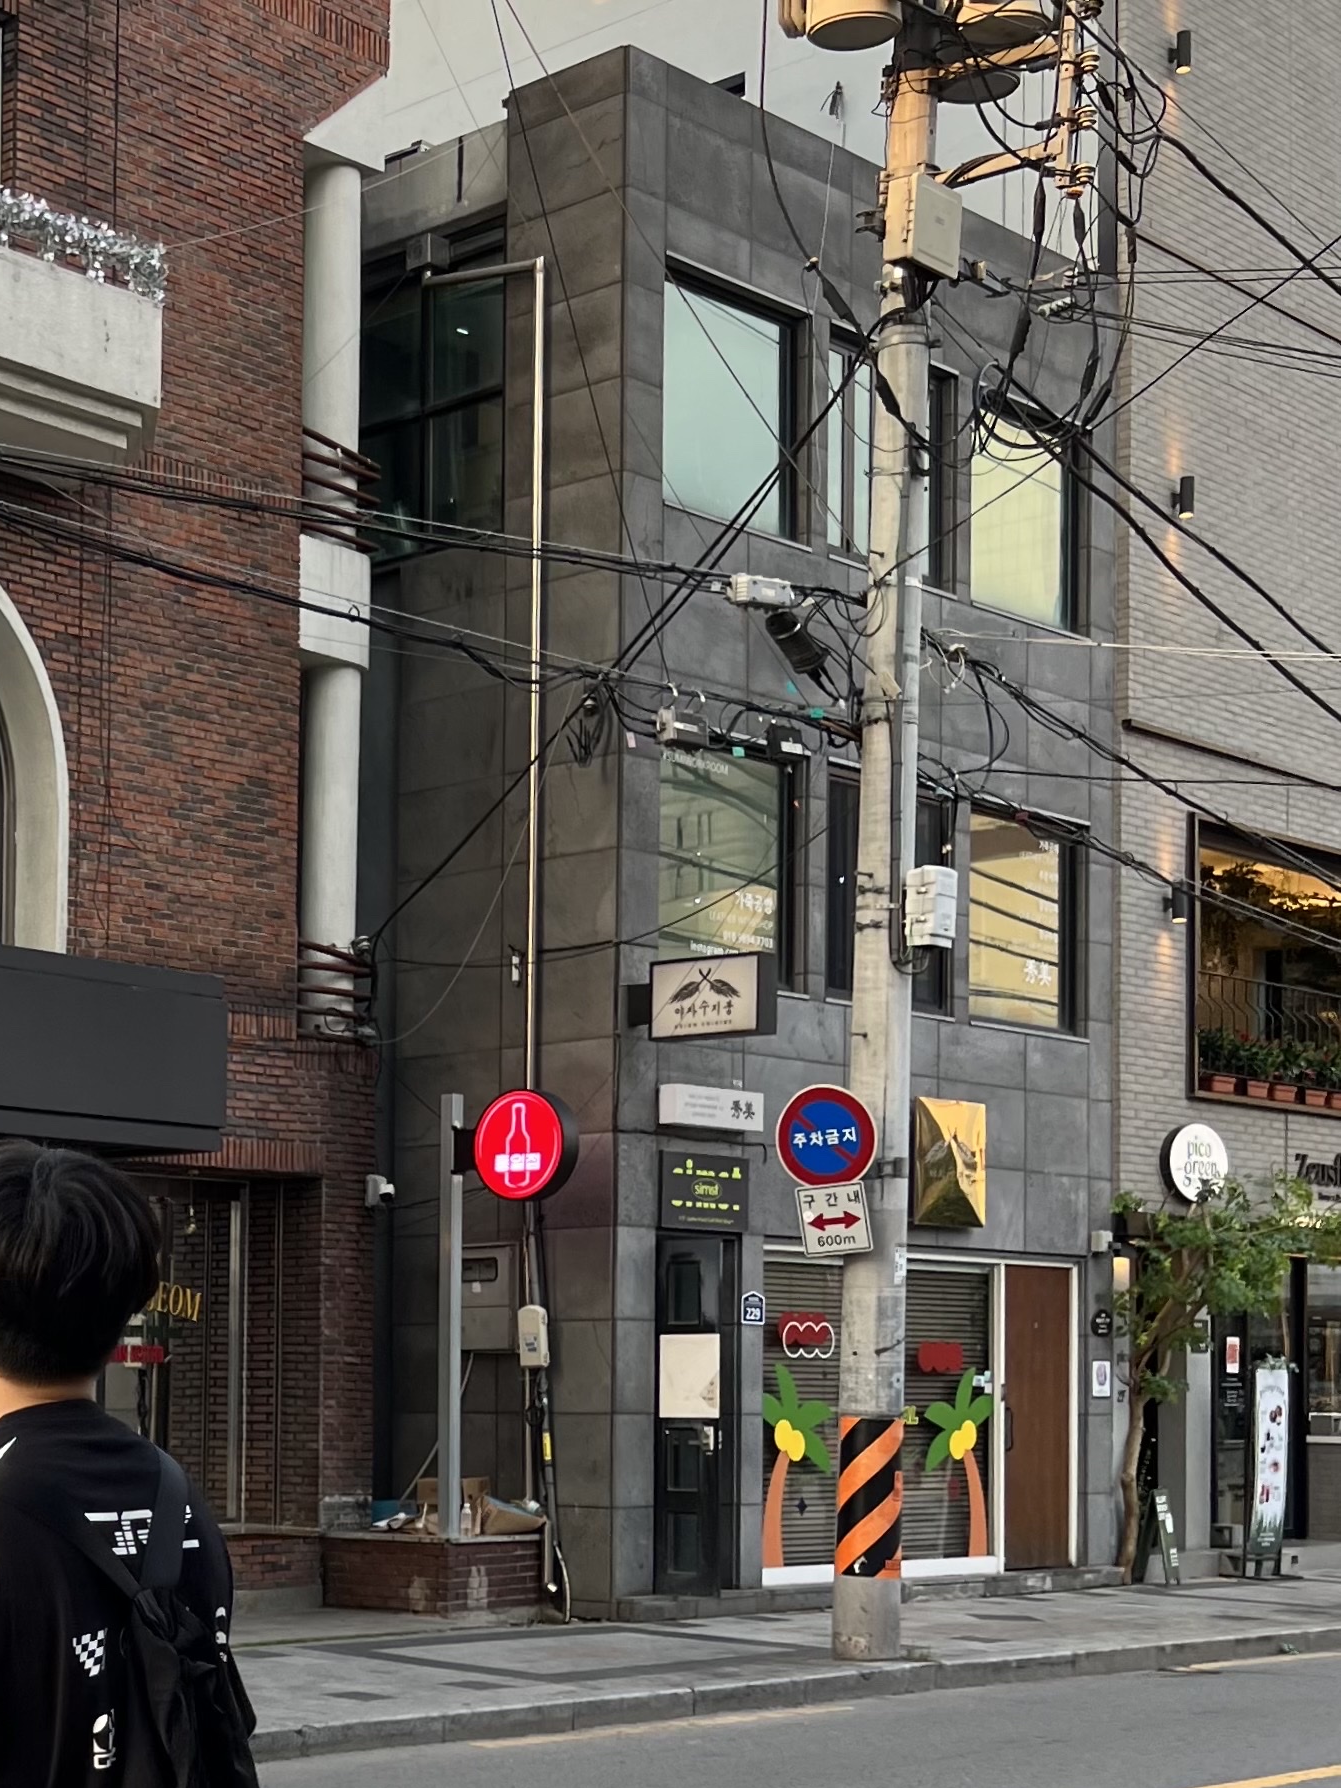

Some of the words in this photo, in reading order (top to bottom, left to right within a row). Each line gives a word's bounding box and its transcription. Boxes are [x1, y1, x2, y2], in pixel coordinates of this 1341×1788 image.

[792, 1126, 857, 1149] 주차금지
[1187, 1135, 1212, 1160] pico
[1182, 1160, 1219, 1188] green
[817, 1234, 857, 1247] 600m
[745, 1307, 761, 1320] 229
